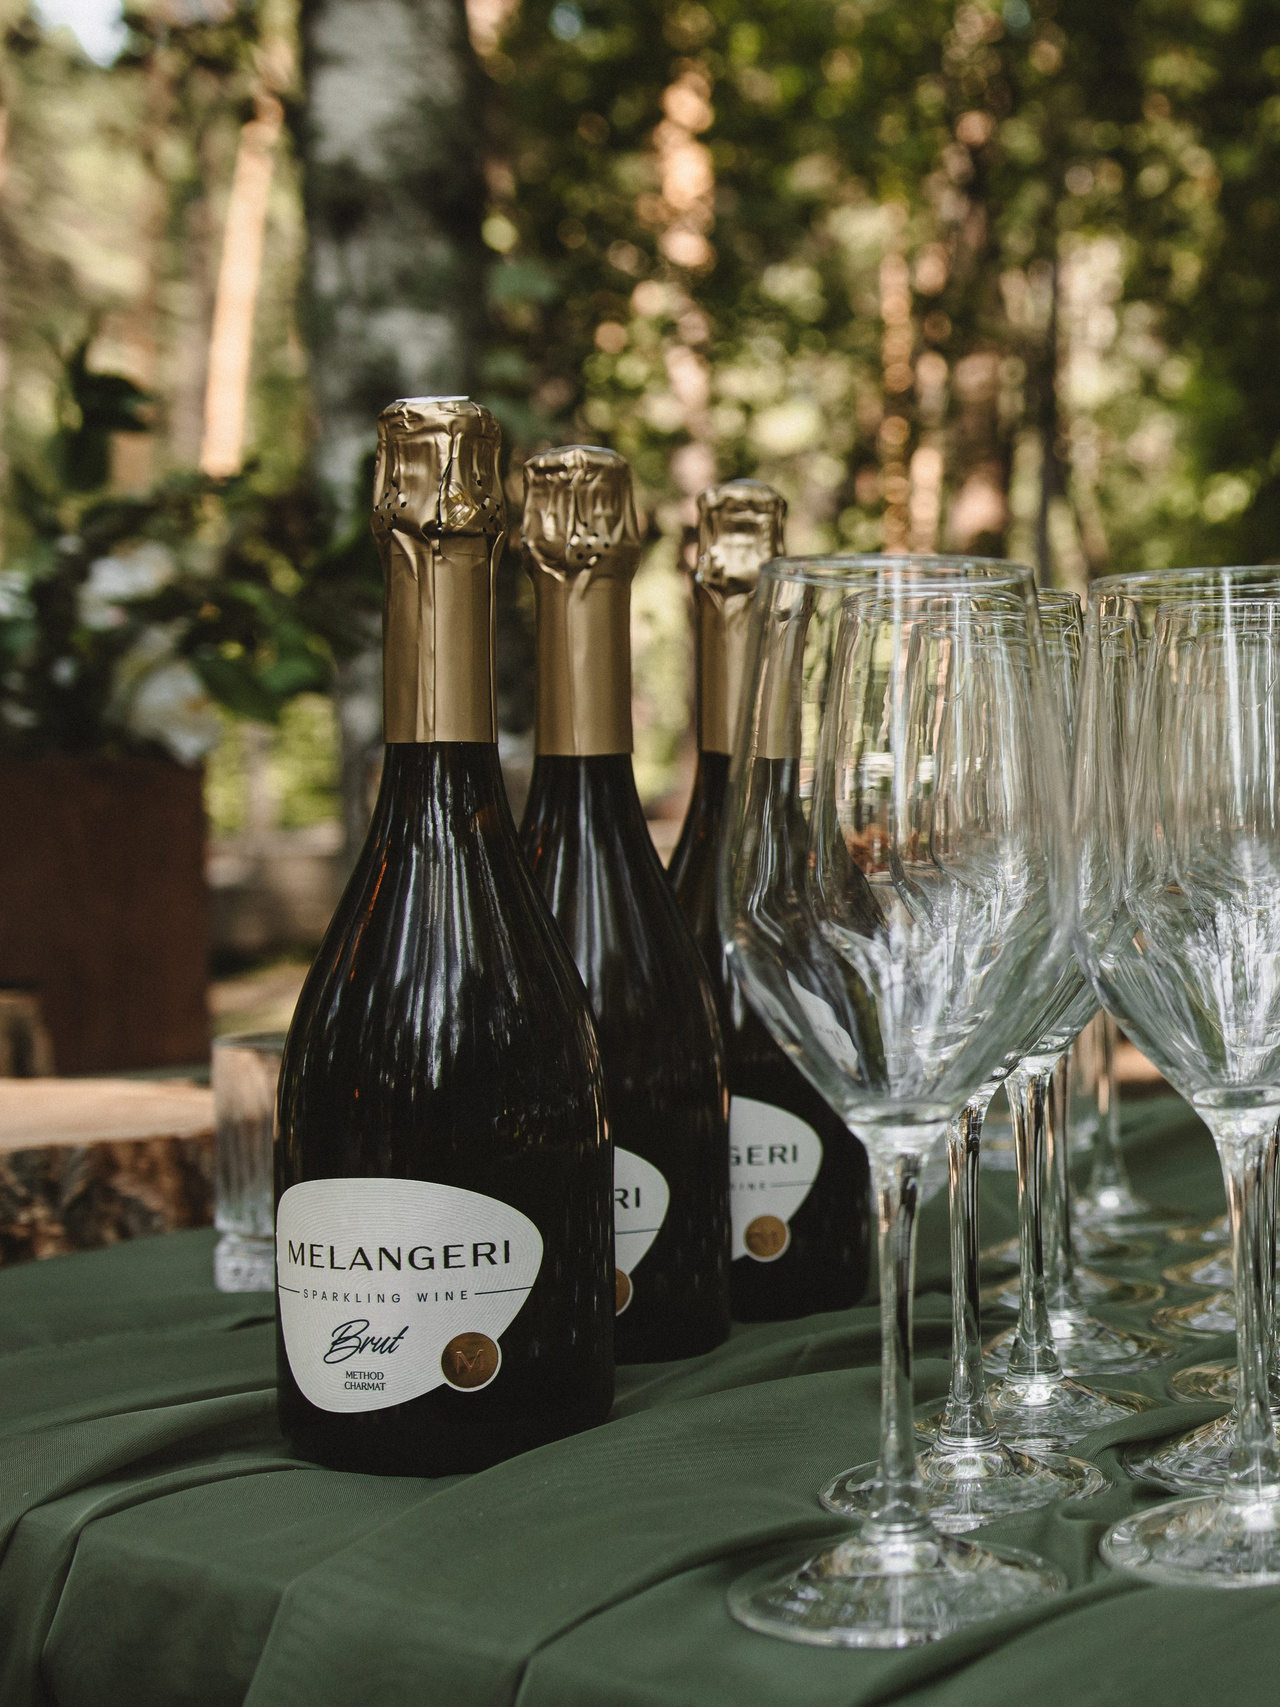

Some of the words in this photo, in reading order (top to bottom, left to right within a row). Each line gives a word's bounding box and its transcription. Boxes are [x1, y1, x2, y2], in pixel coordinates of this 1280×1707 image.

[288, 1240, 510, 1271] MELANGERI
[303, 1288, 401, 1303] SPARKLING
[417, 1290, 468, 1303] WINE
[323, 1319, 409, 1364] Brut
[455, 1349, 485, 1374] M
[344, 1381, 386, 1391] CHARMAT
[345, 1371, 385, 1381] METHOD
